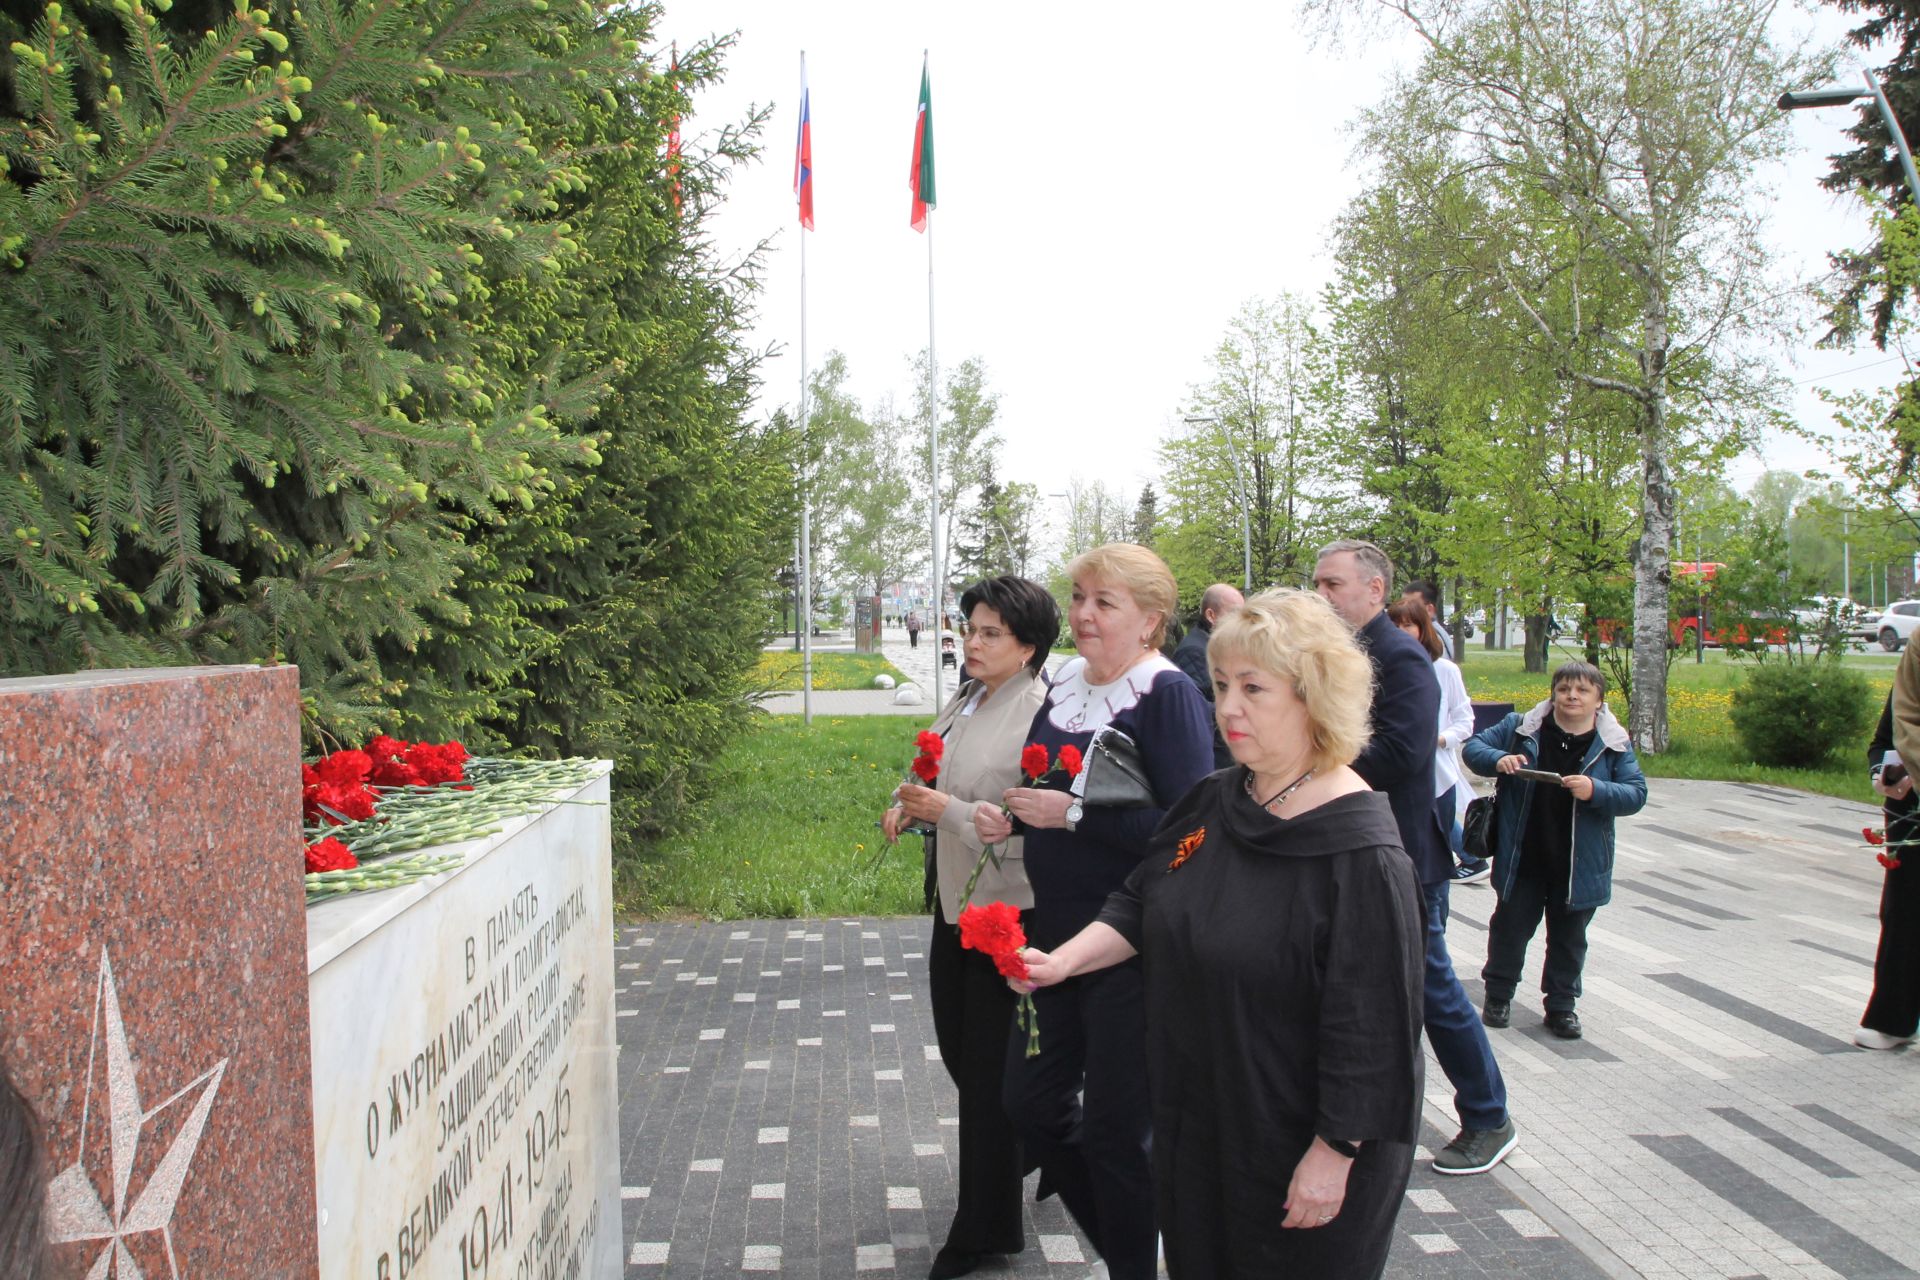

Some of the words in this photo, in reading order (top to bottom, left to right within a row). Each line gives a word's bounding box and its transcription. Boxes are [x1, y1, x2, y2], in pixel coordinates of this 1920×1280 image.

[367, 1101, 380, 1159] О
[388, 974, 498, 1139] ЖУРНАЛИСТАХ
[502, 961, 510, 1007] И
[514, 883, 587, 993] ПОЛИГРАФИСТАХ,
[465, 936, 476, 985] В
[487, 882, 538, 962] ПАМЯТЬ
[398, 1131, 473, 1280] ВЕЛИКОЙ
[476, 1006, 561, 1163] ОТЕЧЕСТВЕННОЙ
[562, 973, 586, 1036] ВОЙНЕ
[437, 1003, 524, 1152] ЗАЩИЩАВШИХ
[528, 957, 561, 1033] РОДИНУ
